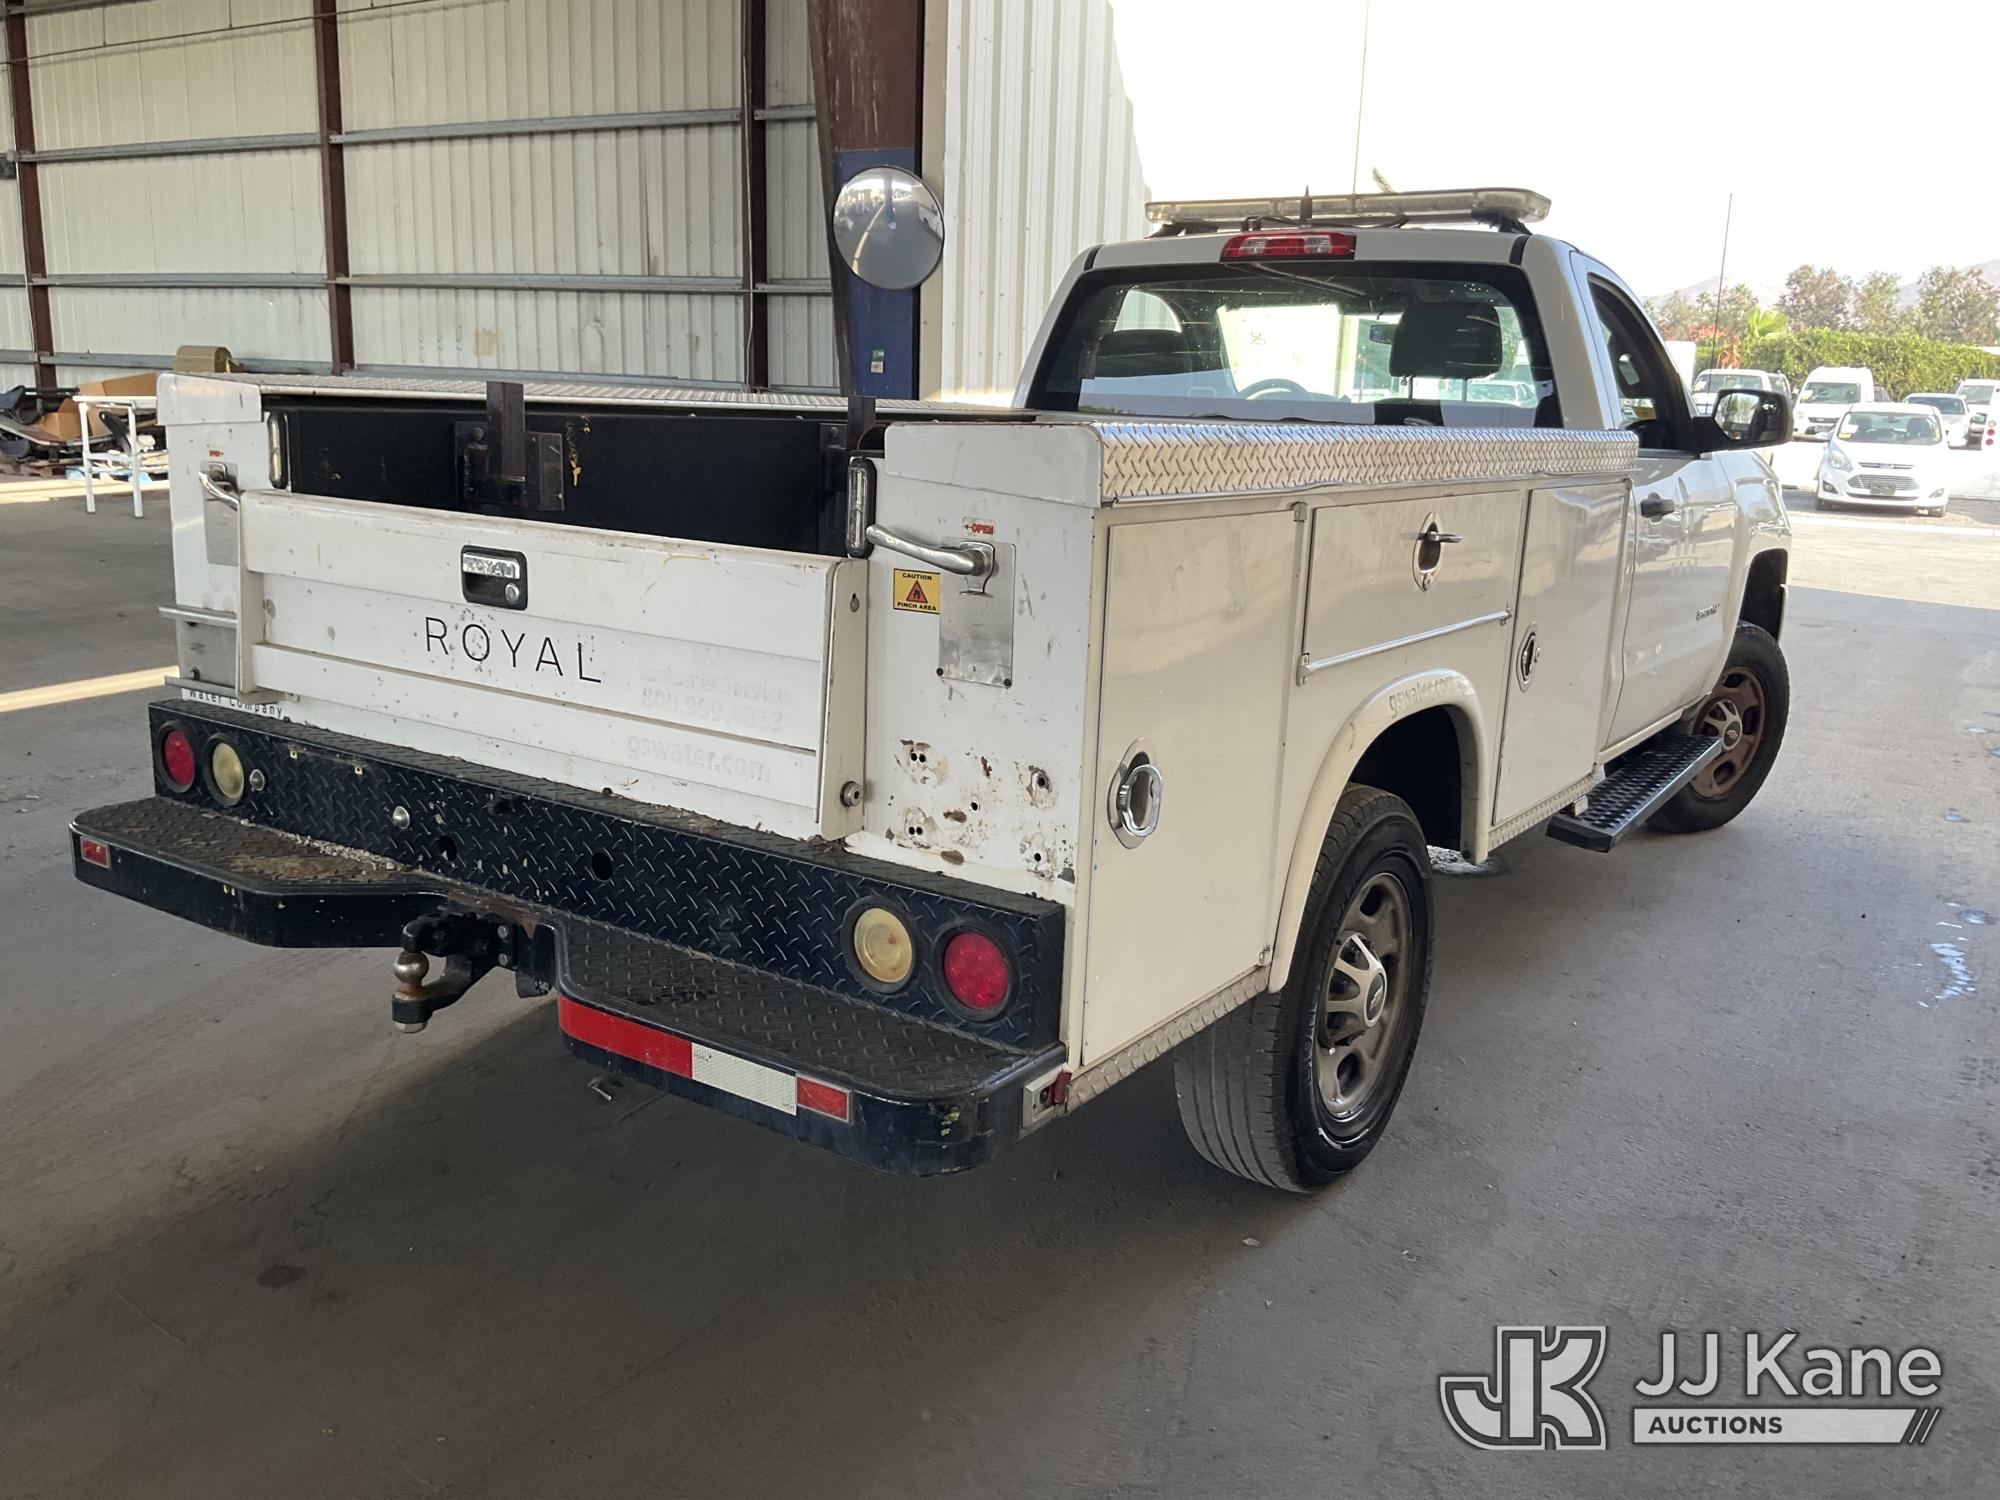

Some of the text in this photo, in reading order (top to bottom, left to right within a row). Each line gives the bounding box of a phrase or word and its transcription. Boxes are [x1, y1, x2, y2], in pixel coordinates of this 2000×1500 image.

[971, 523, 994, 535] OPEN
[902, 572, 933, 581] CAUTION
[897, 601, 937, 612] PINCH AREA
[425, 616, 601, 683] ROYAL
